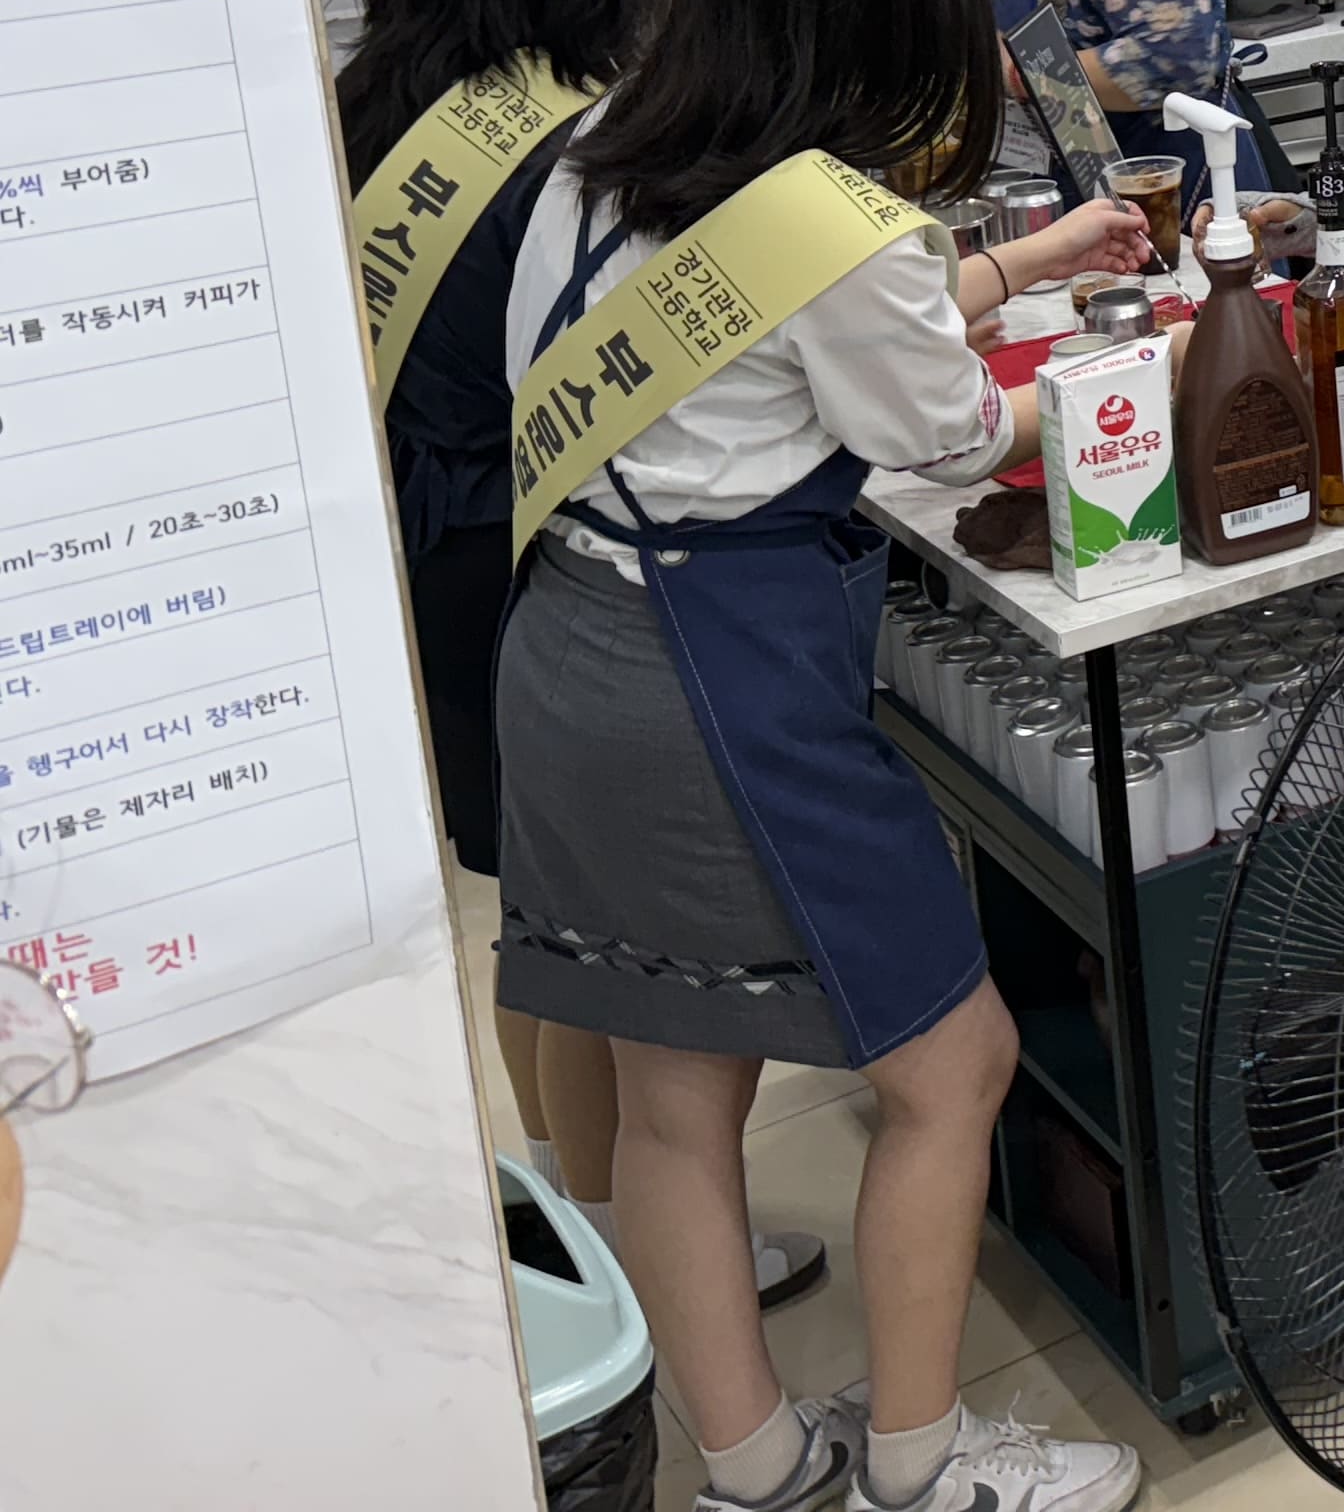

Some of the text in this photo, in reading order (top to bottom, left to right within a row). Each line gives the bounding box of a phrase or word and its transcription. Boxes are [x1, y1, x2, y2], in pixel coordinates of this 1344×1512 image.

[448, 95, 521, 157] 고등학교
[473, 73, 547, 137] 경기관광
[60, 158, 150, 192] 부어줌)
[61, 296, 167, 334] 작동시켜
[184, 278, 261, 311] 커피가
[647, 271, 724, 356] 고등학교
[673, 246, 755, 338] 경기관광
[1076, 430, 1163, 469] 서울우유
[1093, 458, 1150, 481] SEOUL MILK
[0, 493, 280, 575] ml~35ml / 20초~30초)
[0, 585, 227, 659] 드립트레이에 버림)
[0, 675, 41, 705] 다.
[27, 733, 130, 778] 헹구어서
[143, 714, 192, 744] 다시
[205, 685, 310, 729] 장착한다.
[17, 760, 269, 850] (기물은 제자리 배치)
[8, 931, 93, 969] 때는
[146, 933, 197, 976] 것!
